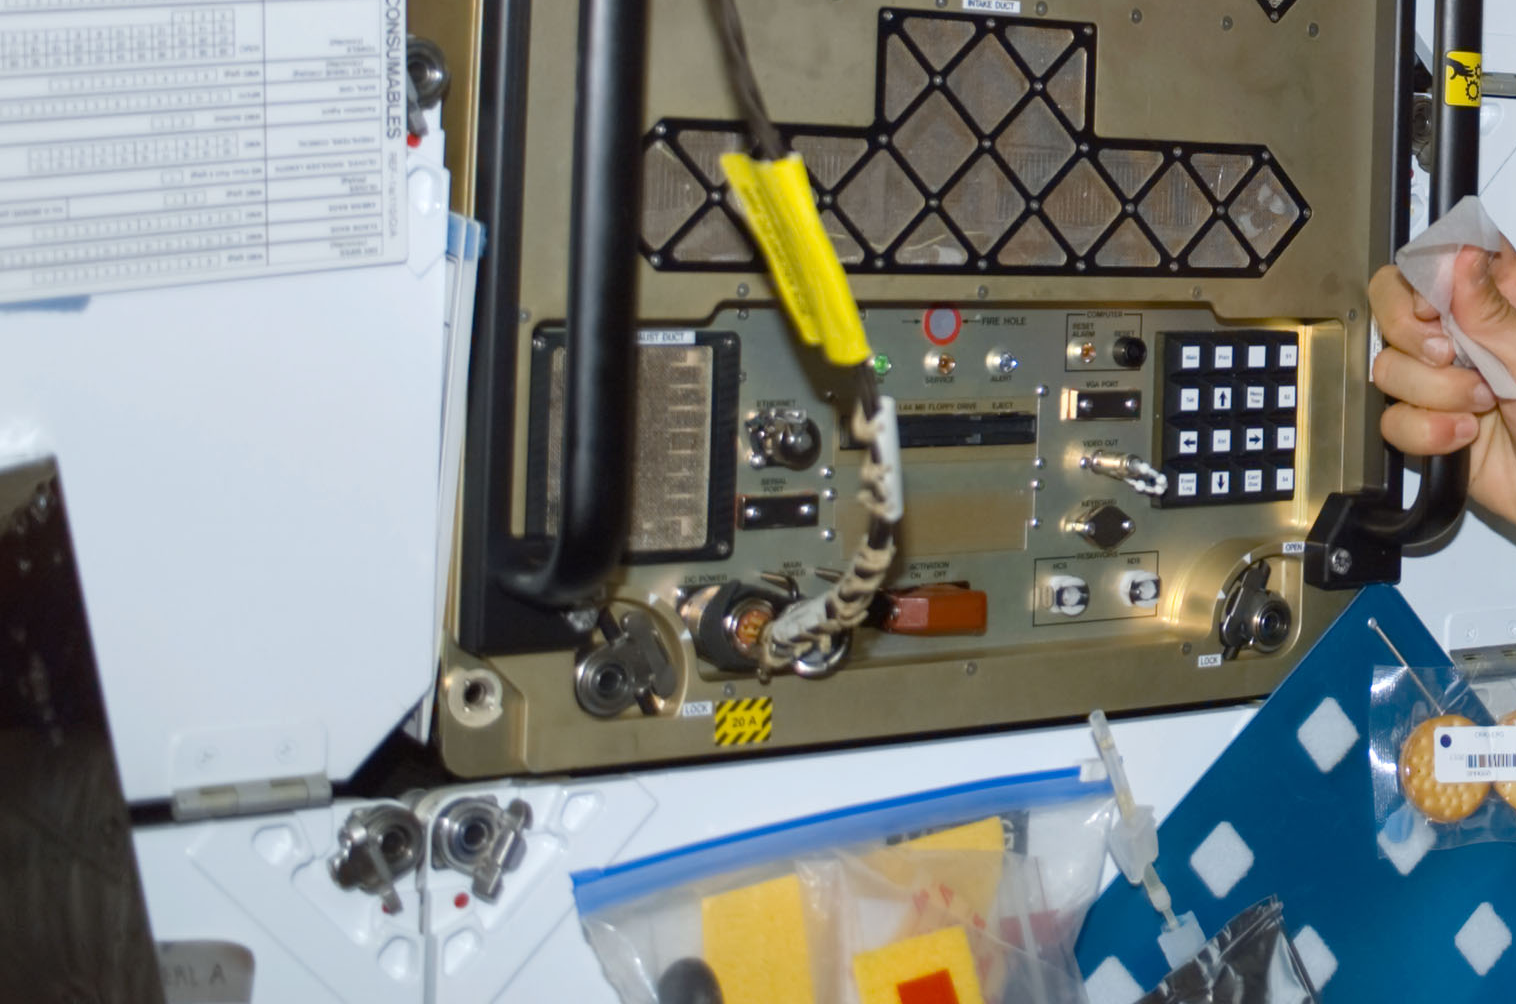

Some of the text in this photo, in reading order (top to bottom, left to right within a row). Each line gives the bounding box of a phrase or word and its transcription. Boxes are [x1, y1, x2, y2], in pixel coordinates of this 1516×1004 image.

[994, 2, 1015, 10] DUCT
[982, 316, 1026, 326] FIRE HOLE
[1284, 544, 1302, 552] OPEN
[685, 704, 709, 714] LOCK
[732, 715, 758, 728] 20 A
